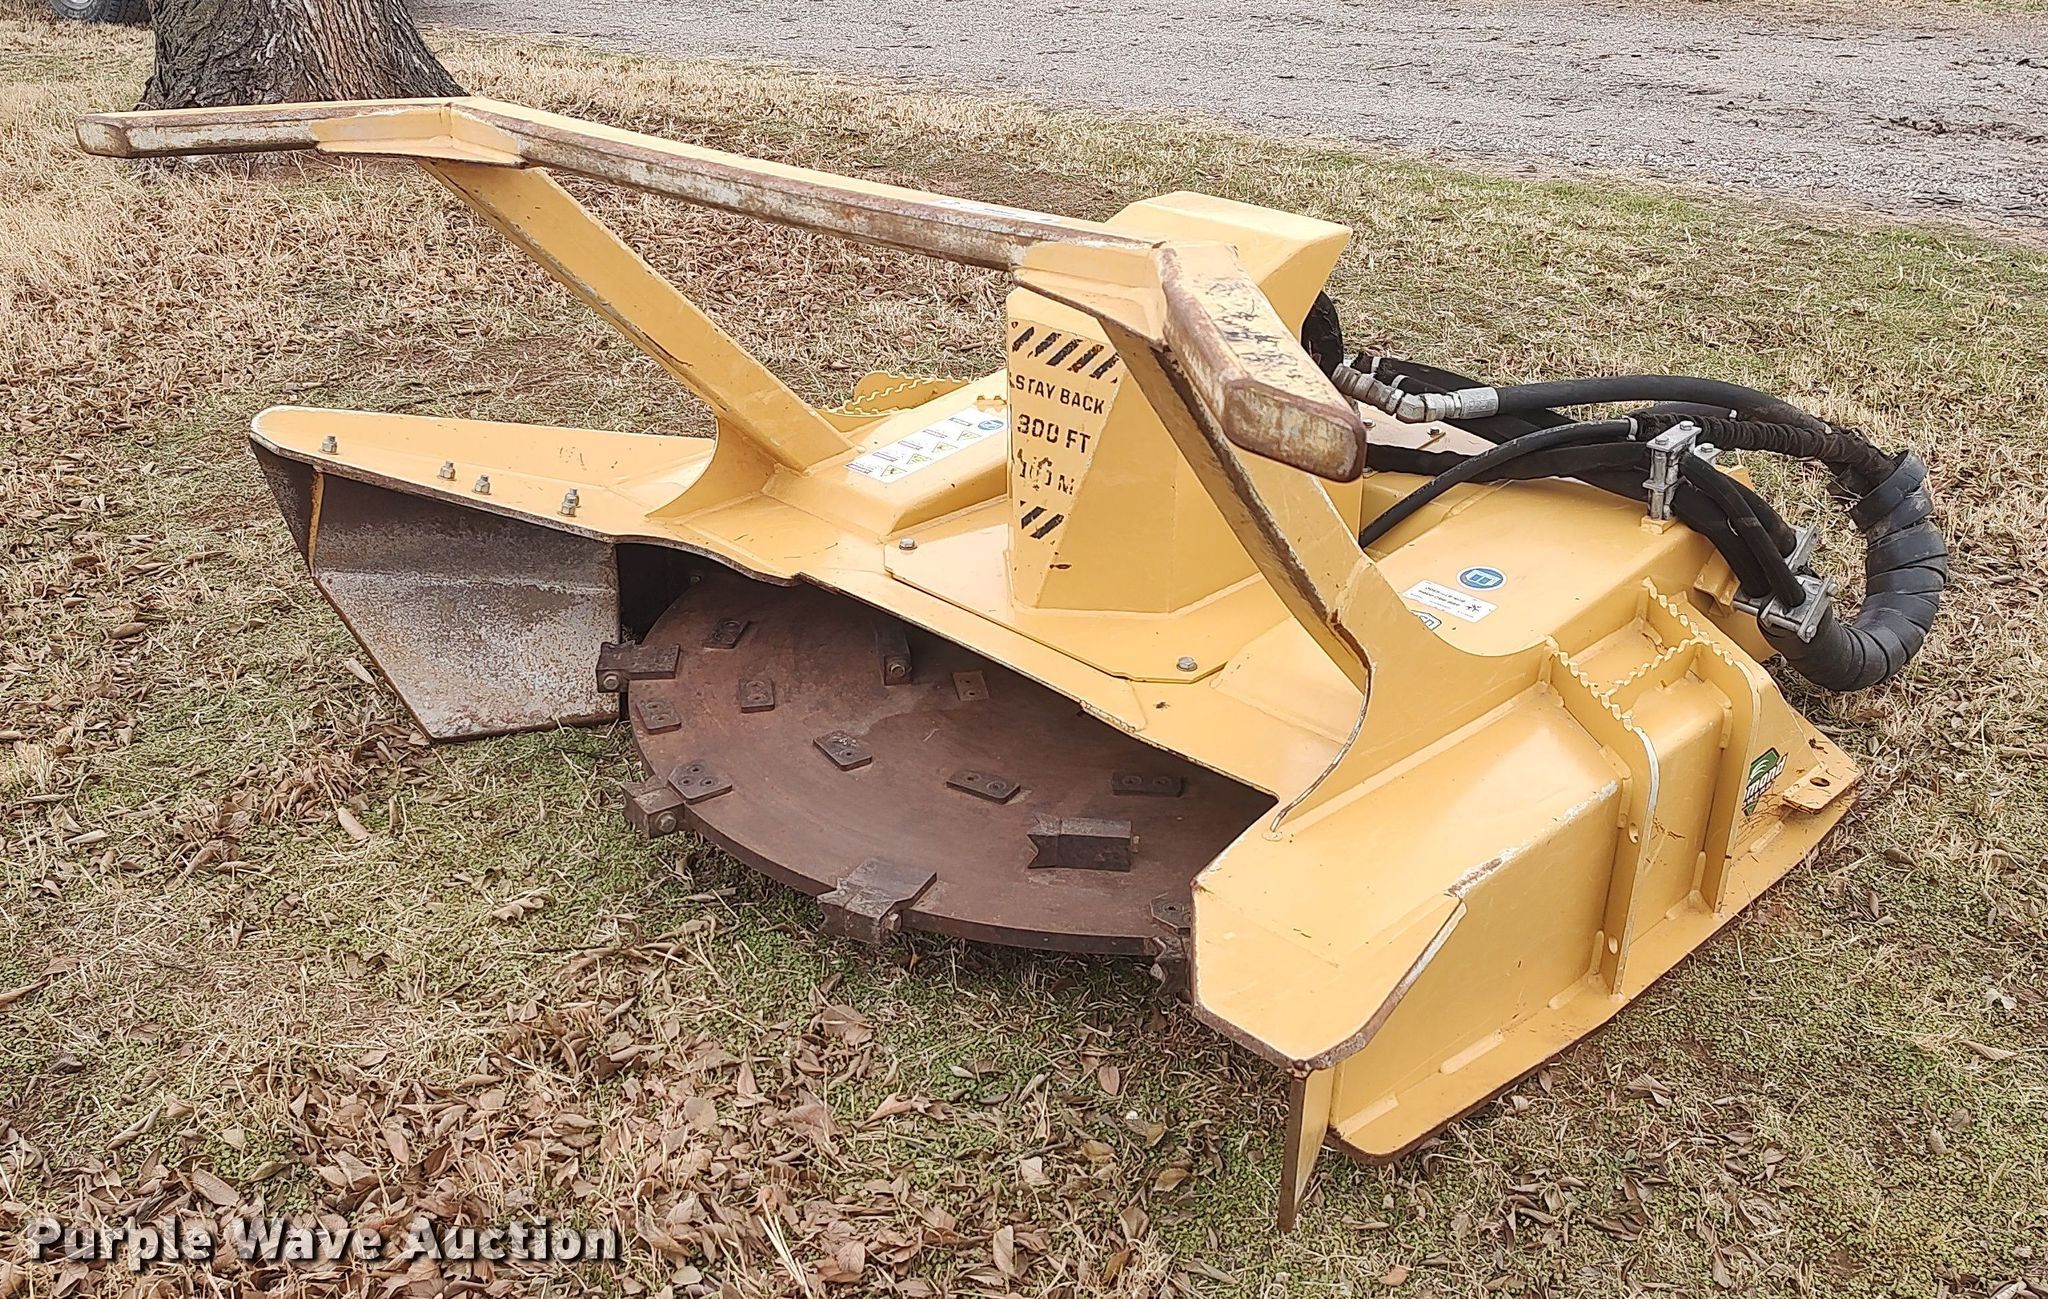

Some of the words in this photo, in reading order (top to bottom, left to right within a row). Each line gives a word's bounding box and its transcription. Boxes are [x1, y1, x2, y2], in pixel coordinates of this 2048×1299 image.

[1015, 374, 1056, 399] STAY
[1060, 387, 1105, 415] BACK
[1017, 413, 1059, 444] 300
[1065, 430, 1091, 453] FT
